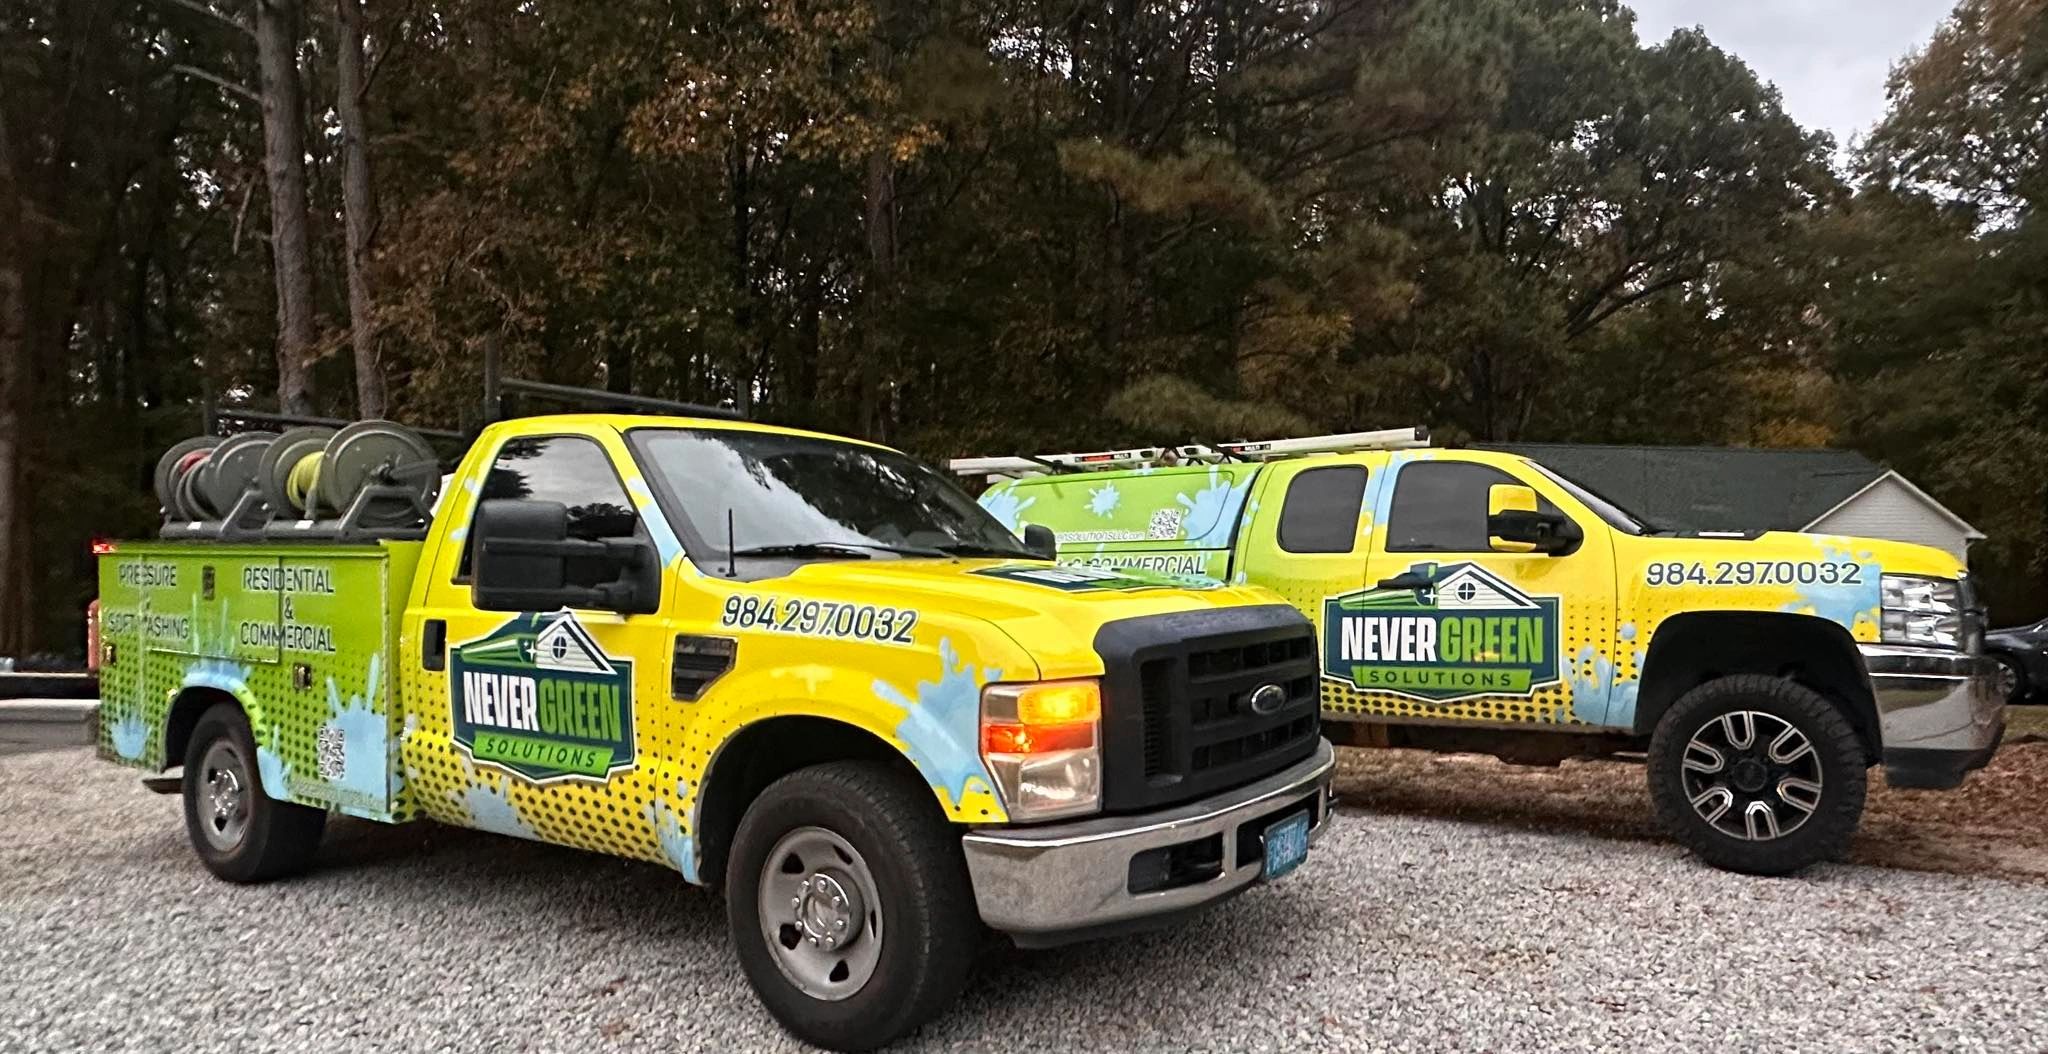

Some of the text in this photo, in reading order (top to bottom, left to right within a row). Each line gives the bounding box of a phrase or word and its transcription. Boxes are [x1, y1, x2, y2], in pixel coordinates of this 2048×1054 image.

[243, 567, 334, 593] RESIDENTIAL
[1646, 561, 1862, 585] 984.297.0032
[283, 597, 294, 621] &
[722, 595, 918, 643] 984.297.0032
[241, 622, 336, 652] COMMERCIAL
[1341, 616, 1545, 663] NEVER GREEN
[1367, 670, 1513, 688] SOLUTIONS
[464, 671, 621, 740] NEVER GREEN
[485, 738, 595, 768] SOLUTIONS
